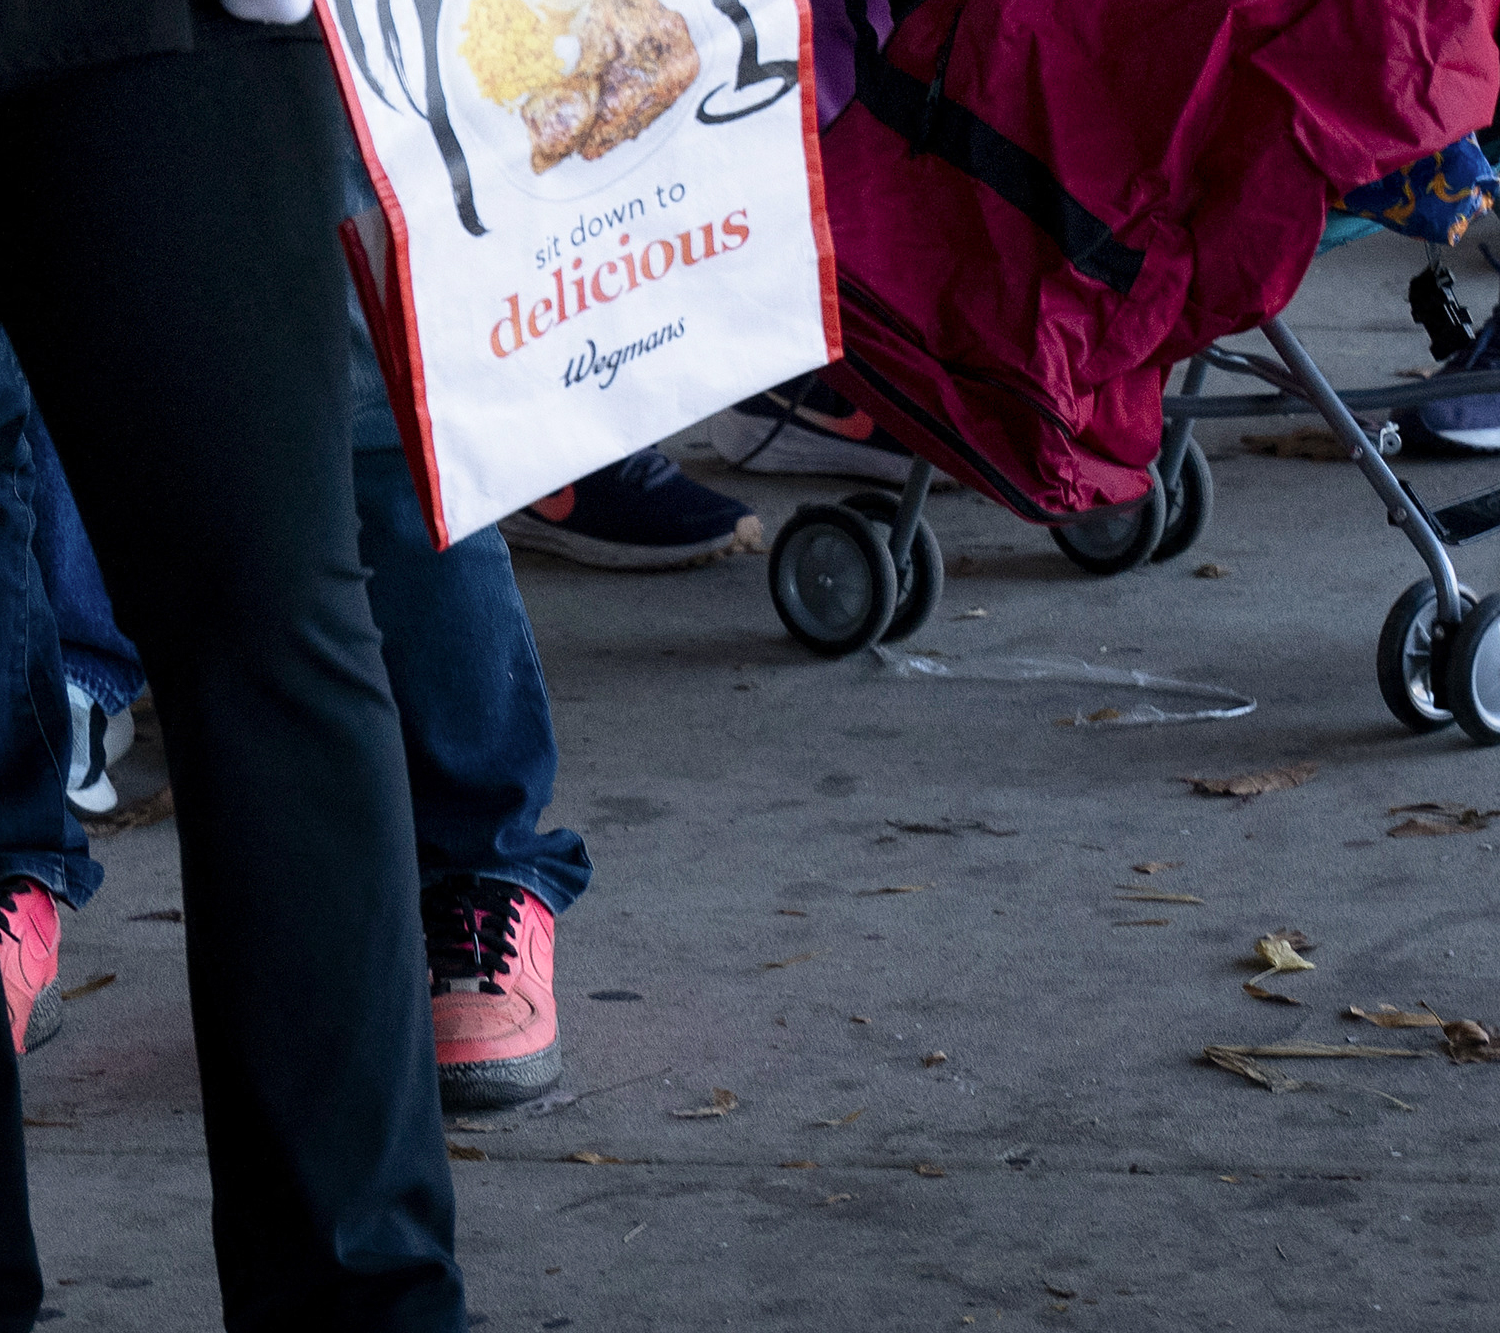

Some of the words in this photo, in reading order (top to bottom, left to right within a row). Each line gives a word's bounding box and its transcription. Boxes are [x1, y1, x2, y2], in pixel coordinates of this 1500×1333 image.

[534, 233, 561, 269] sit
[570, 197, 645, 247] down
[655, 182, 687, 209] to
[489, 207, 750, 359] delicious
[560, 316, 687, 391] Wegmans
